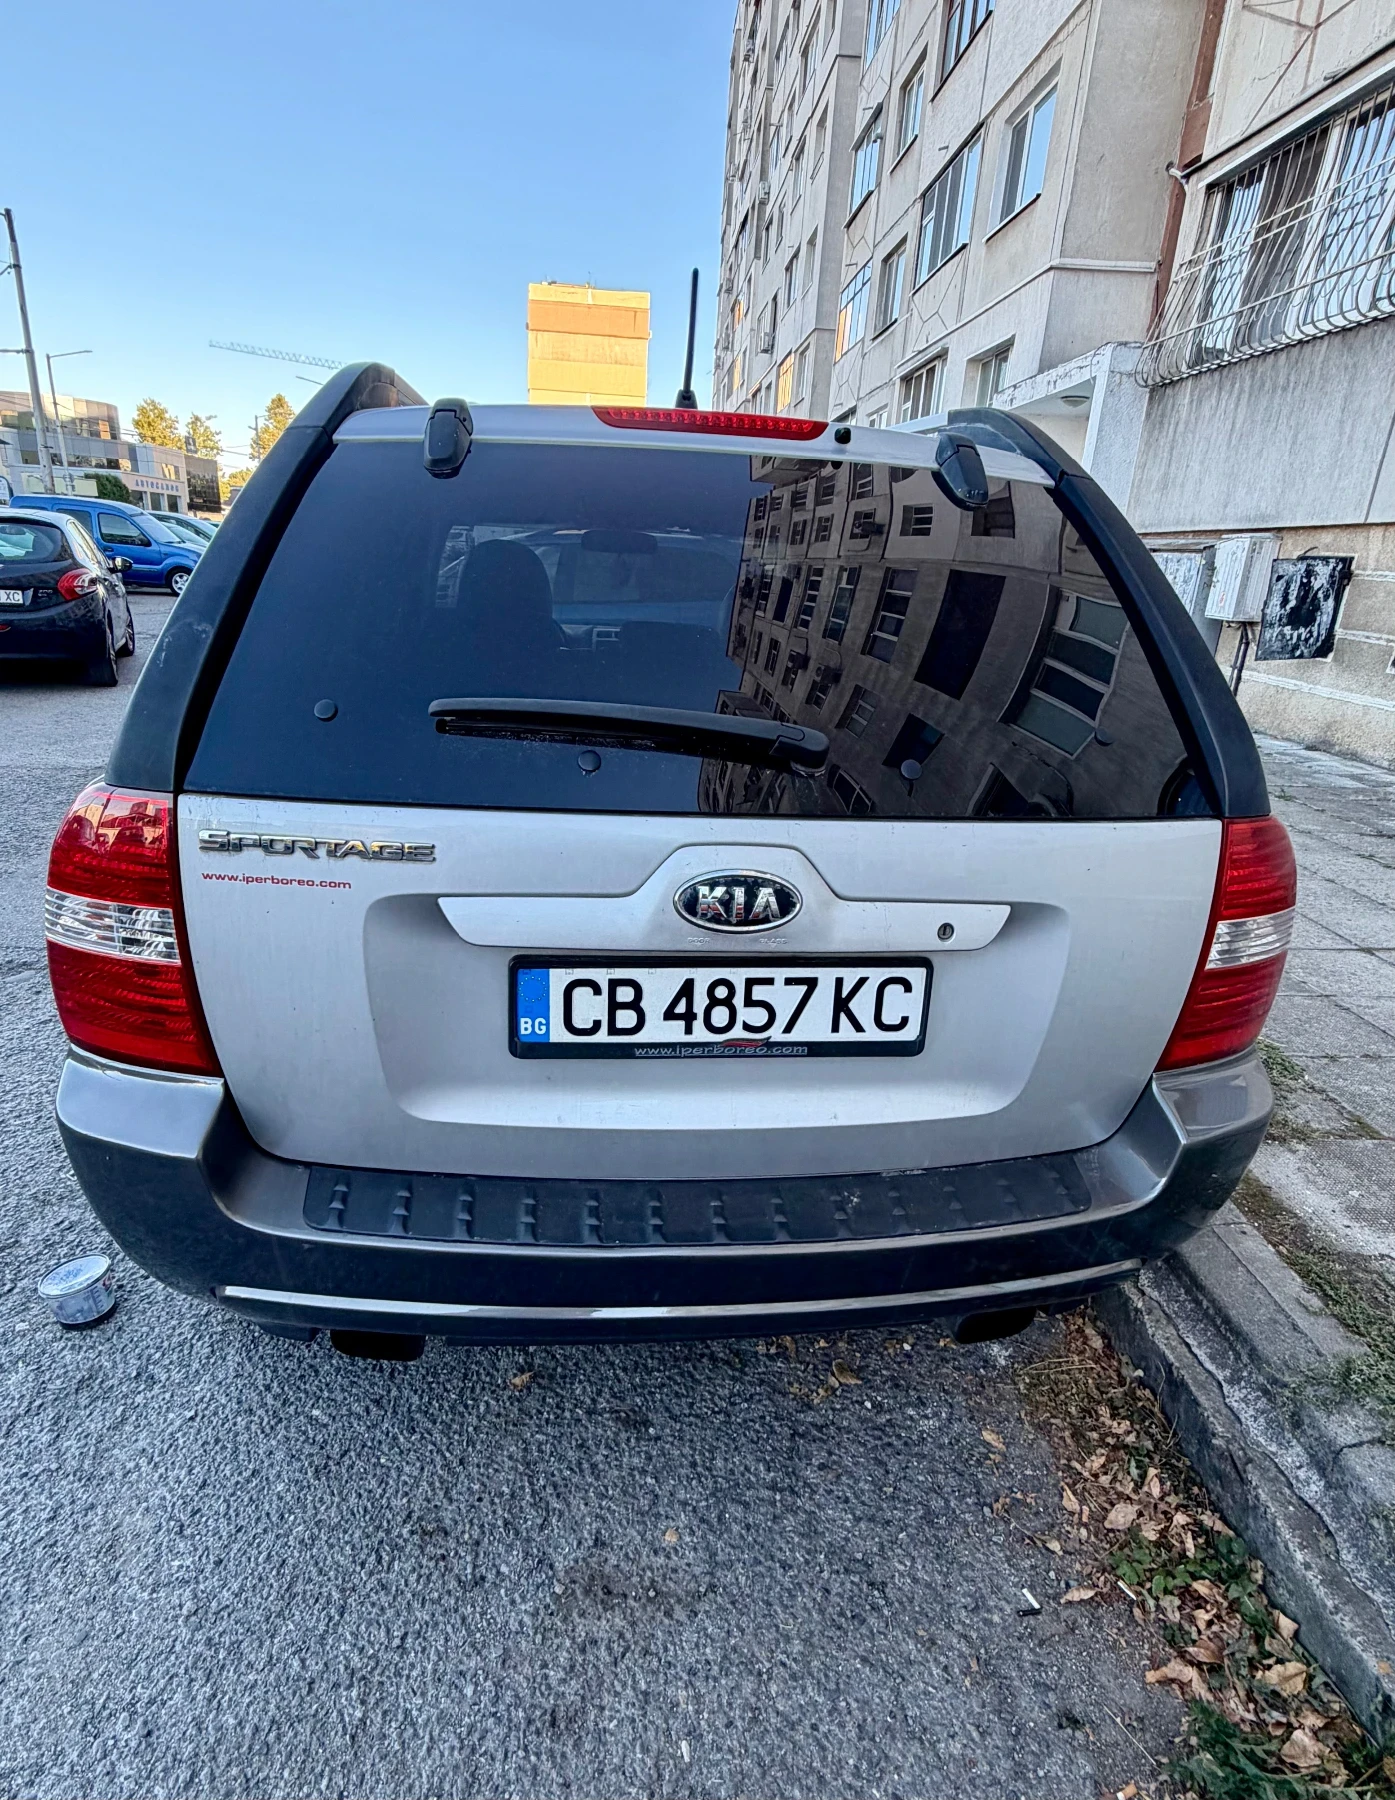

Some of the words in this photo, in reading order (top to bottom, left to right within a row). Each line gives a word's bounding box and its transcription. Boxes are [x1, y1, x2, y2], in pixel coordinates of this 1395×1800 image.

[4, 591, 20, 602] XC
[198, 829, 436, 862] SPORTAGE
[201, 872, 352, 889] www.iperboreo.com
[697, 885, 780, 920] KIA
[563, 977, 646, 1037] CB
[662, 977, 819, 1036] 4857
[831, 976, 913, 1034] KC
[520, 1017, 547, 1035] BG
